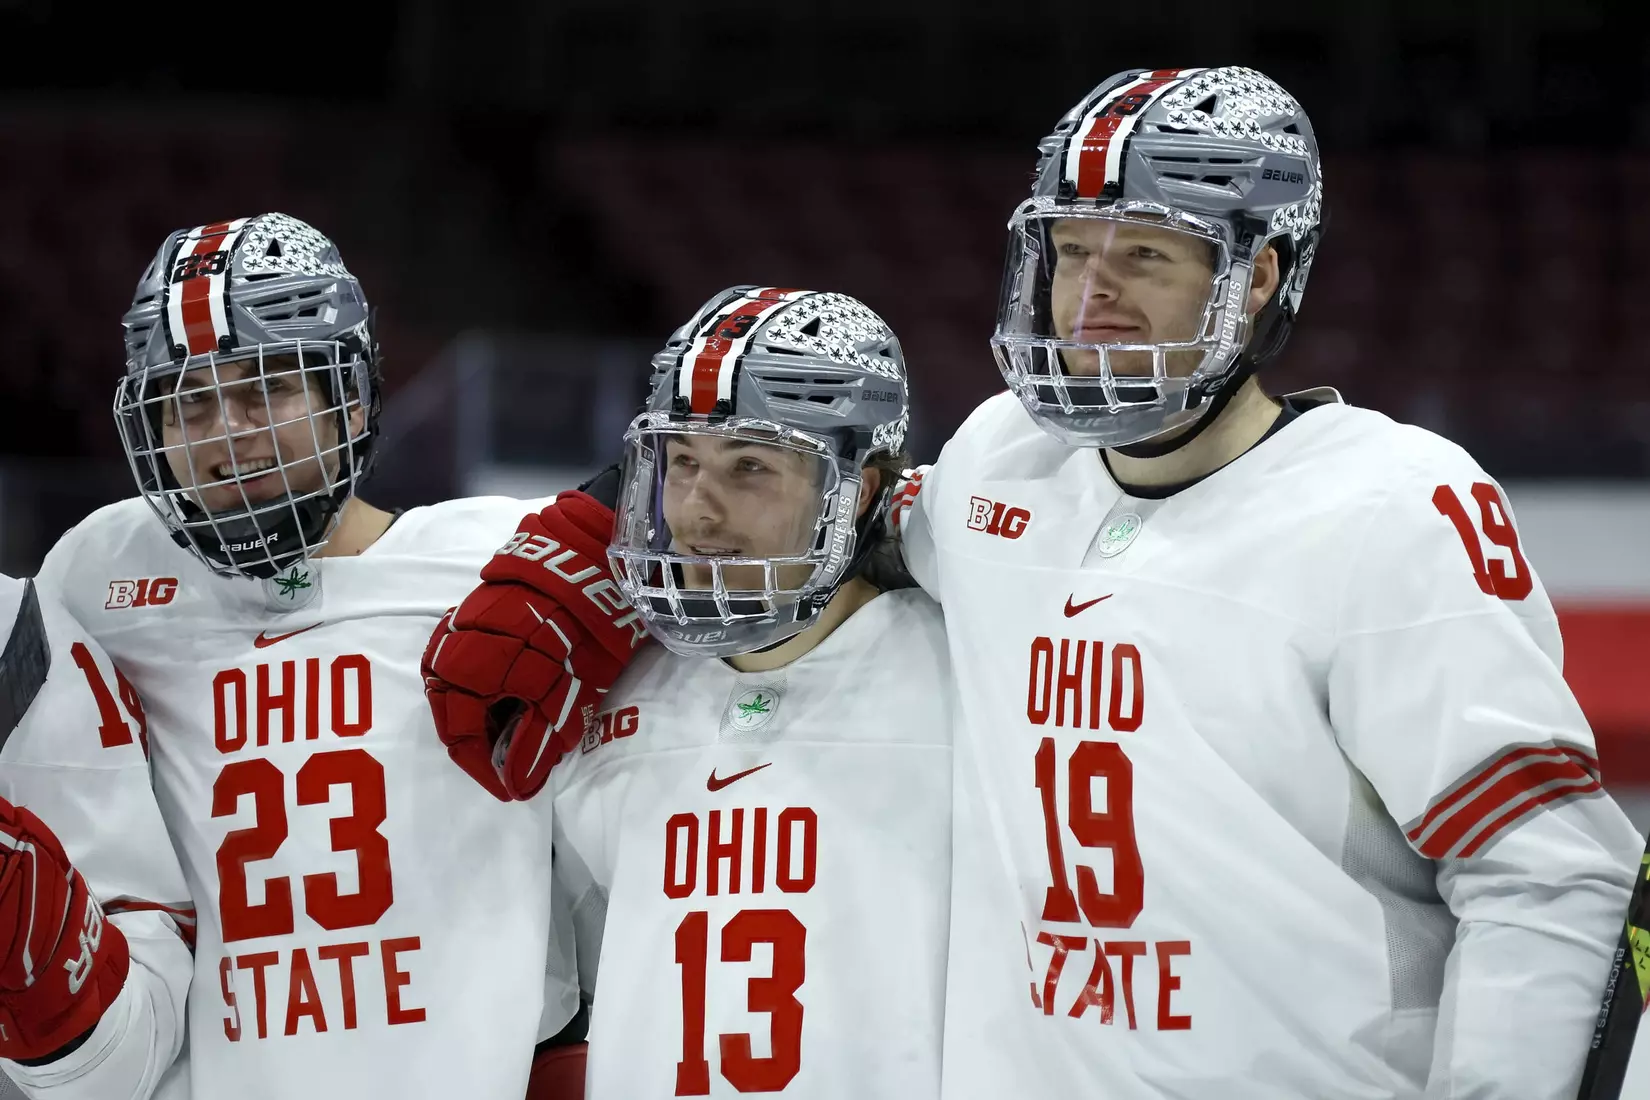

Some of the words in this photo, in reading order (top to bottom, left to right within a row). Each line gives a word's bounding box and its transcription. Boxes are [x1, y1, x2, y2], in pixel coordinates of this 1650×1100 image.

[1262, 169, 1303, 184] BAUER
[700, 314, 760, 339] 13
[1215, 280, 1242, 361] BUCKEYES
[862, 390, 898, 404] BAUER
[220, 532, 278, 551] BAUER
[825, 495, 851, 574] BUCKEYES
[1432, 482, 1533, 601] 19
[496, 532, 650, 648] BAUER
[213, 654, 372, 753] OHIO
[1027, 636, 1143, 732] OHIO
[211, 749, 393, 943] 23
[663, 806, 818, 899] OHIO
[1035, 737, 1144, 929] 19
[220, 936, 426, 1042] STATE
[674, 909, 807, 1096] 13
[1597, 947, 1625, 1028] BUCKEYES
